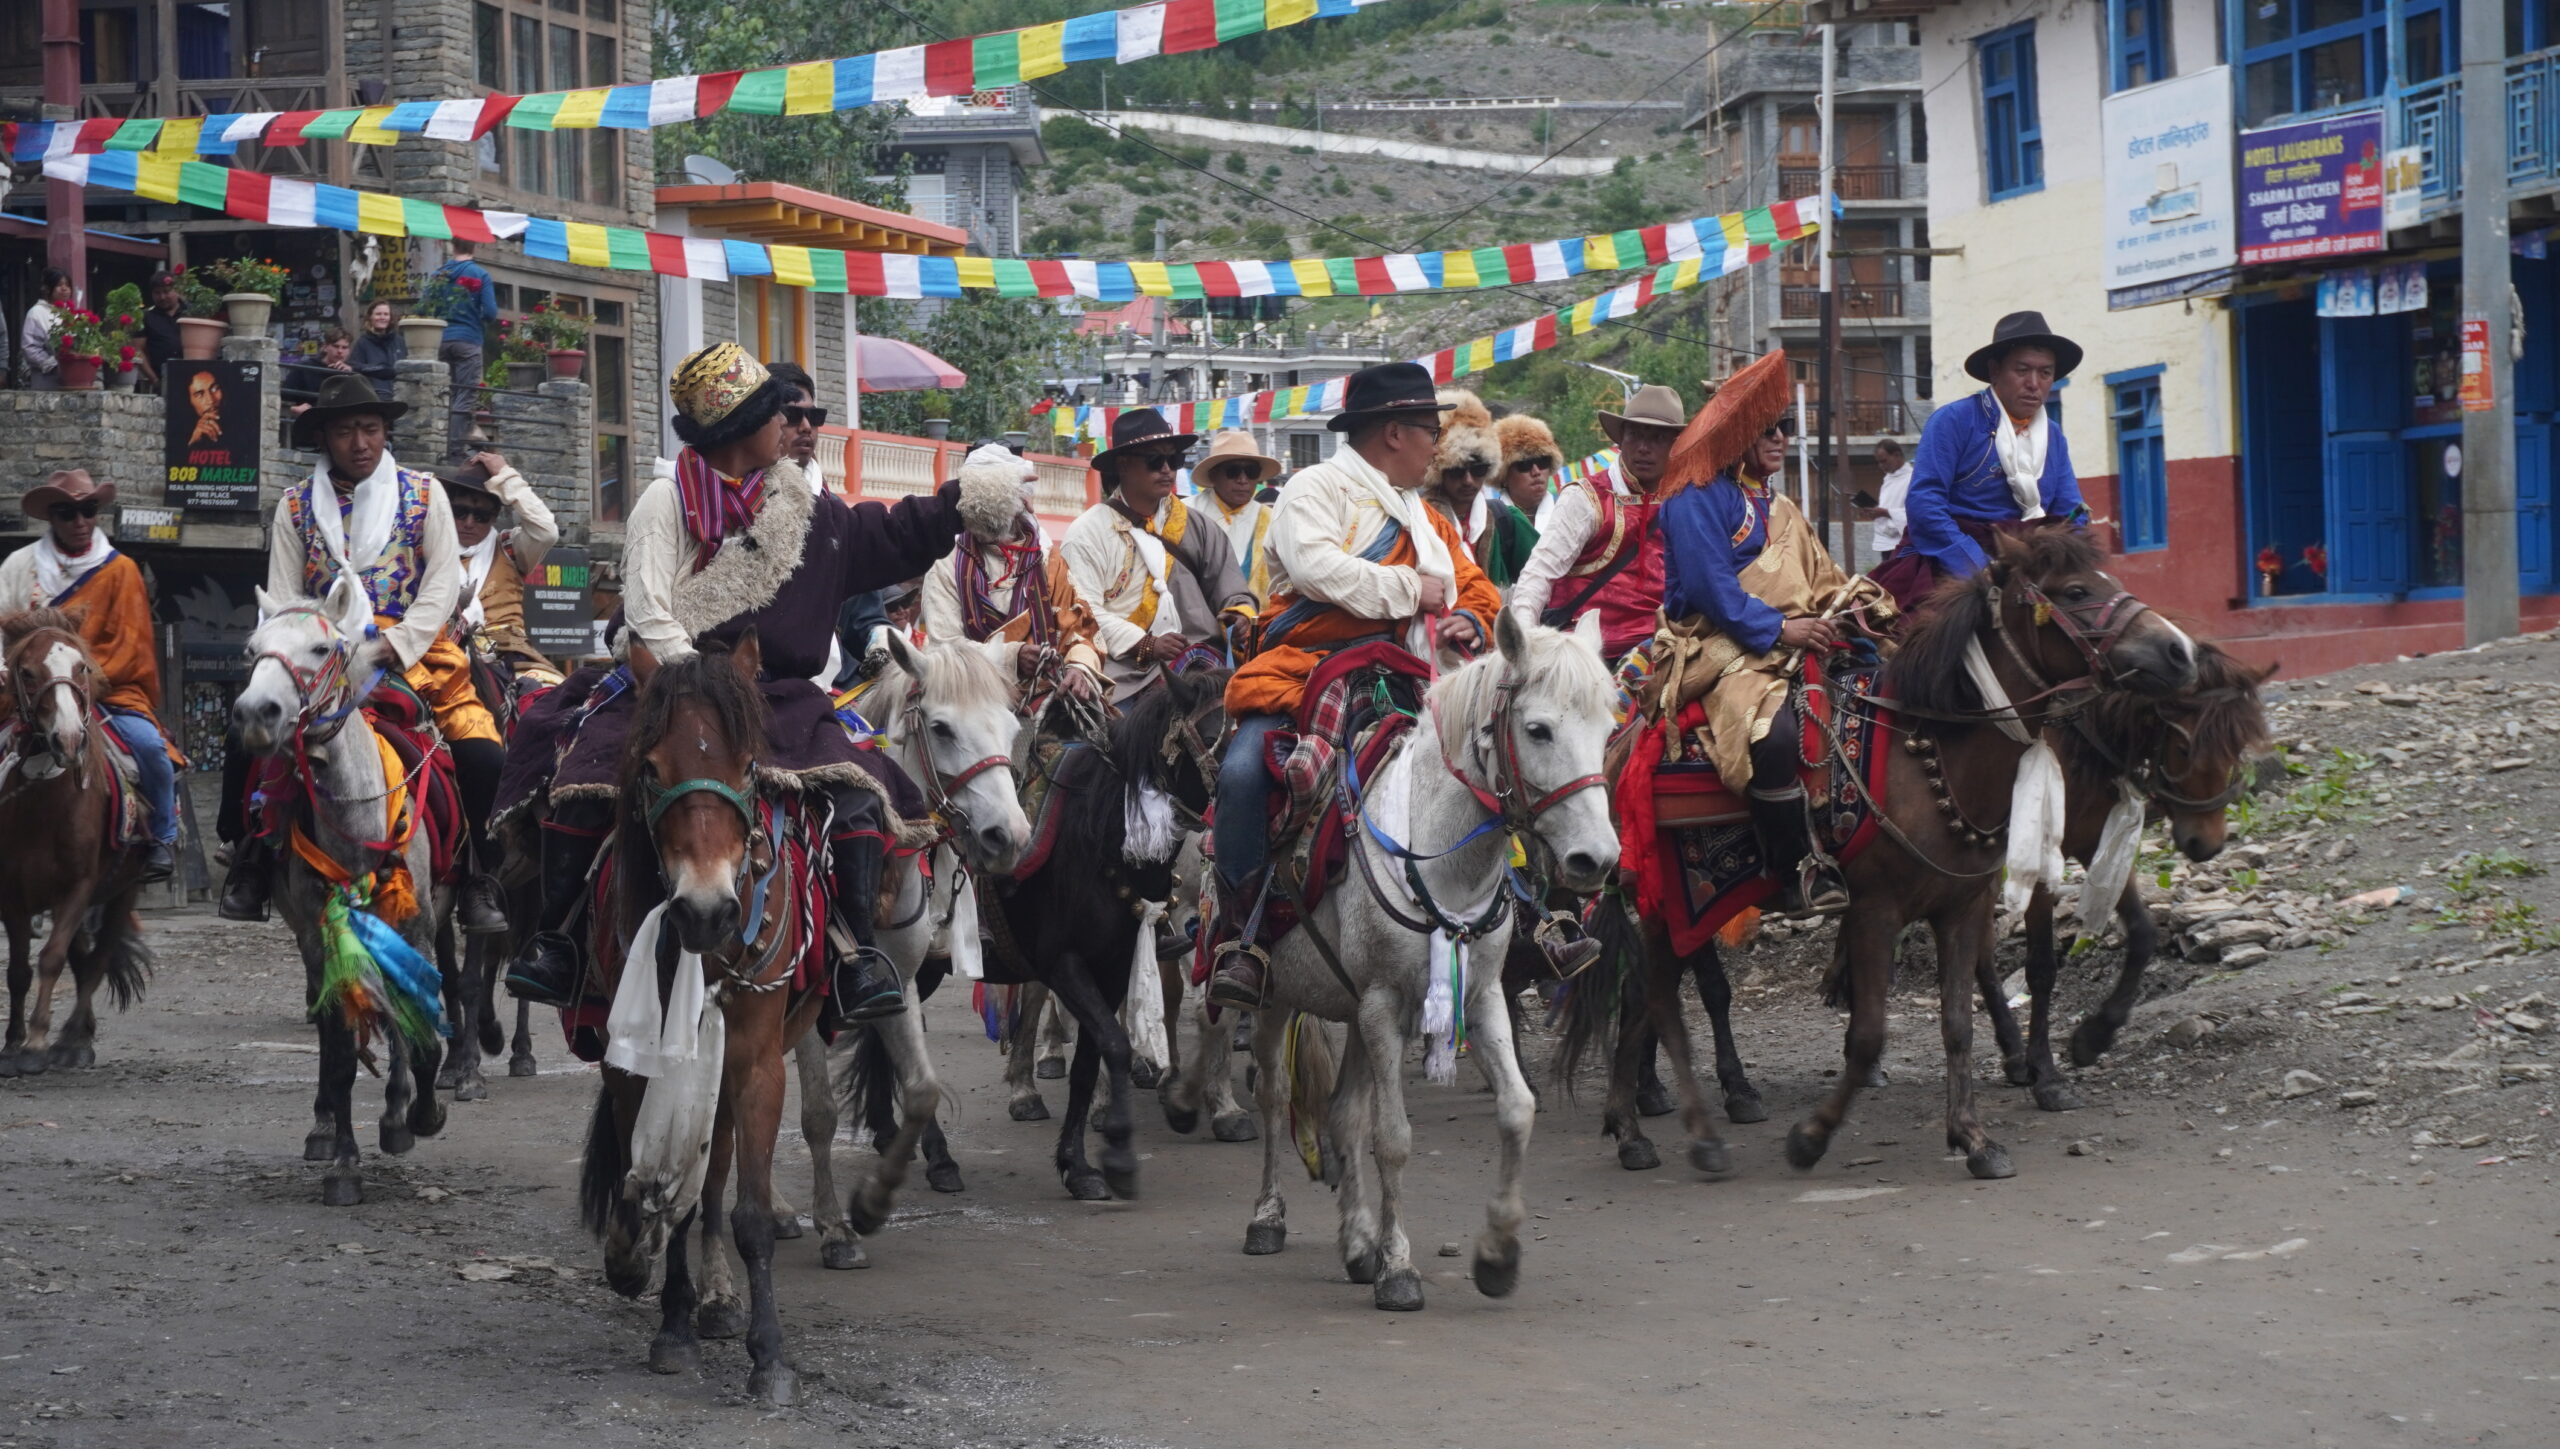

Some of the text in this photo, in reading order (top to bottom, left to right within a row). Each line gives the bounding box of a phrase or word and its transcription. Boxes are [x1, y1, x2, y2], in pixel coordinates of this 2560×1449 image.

[2244, 146, 2276, 168] HOTEL
[2248, 180, 2341, 207] SHARMA KITCHEN
[188, 450, 232, 466] HOTEL
[169, 466, 258, 483] BOB MARLEY
[121, 509, 173, 526] FREEDOM
[546, 564, 561, 587] BOB
[562, 566, 589, 588] MARLEY
